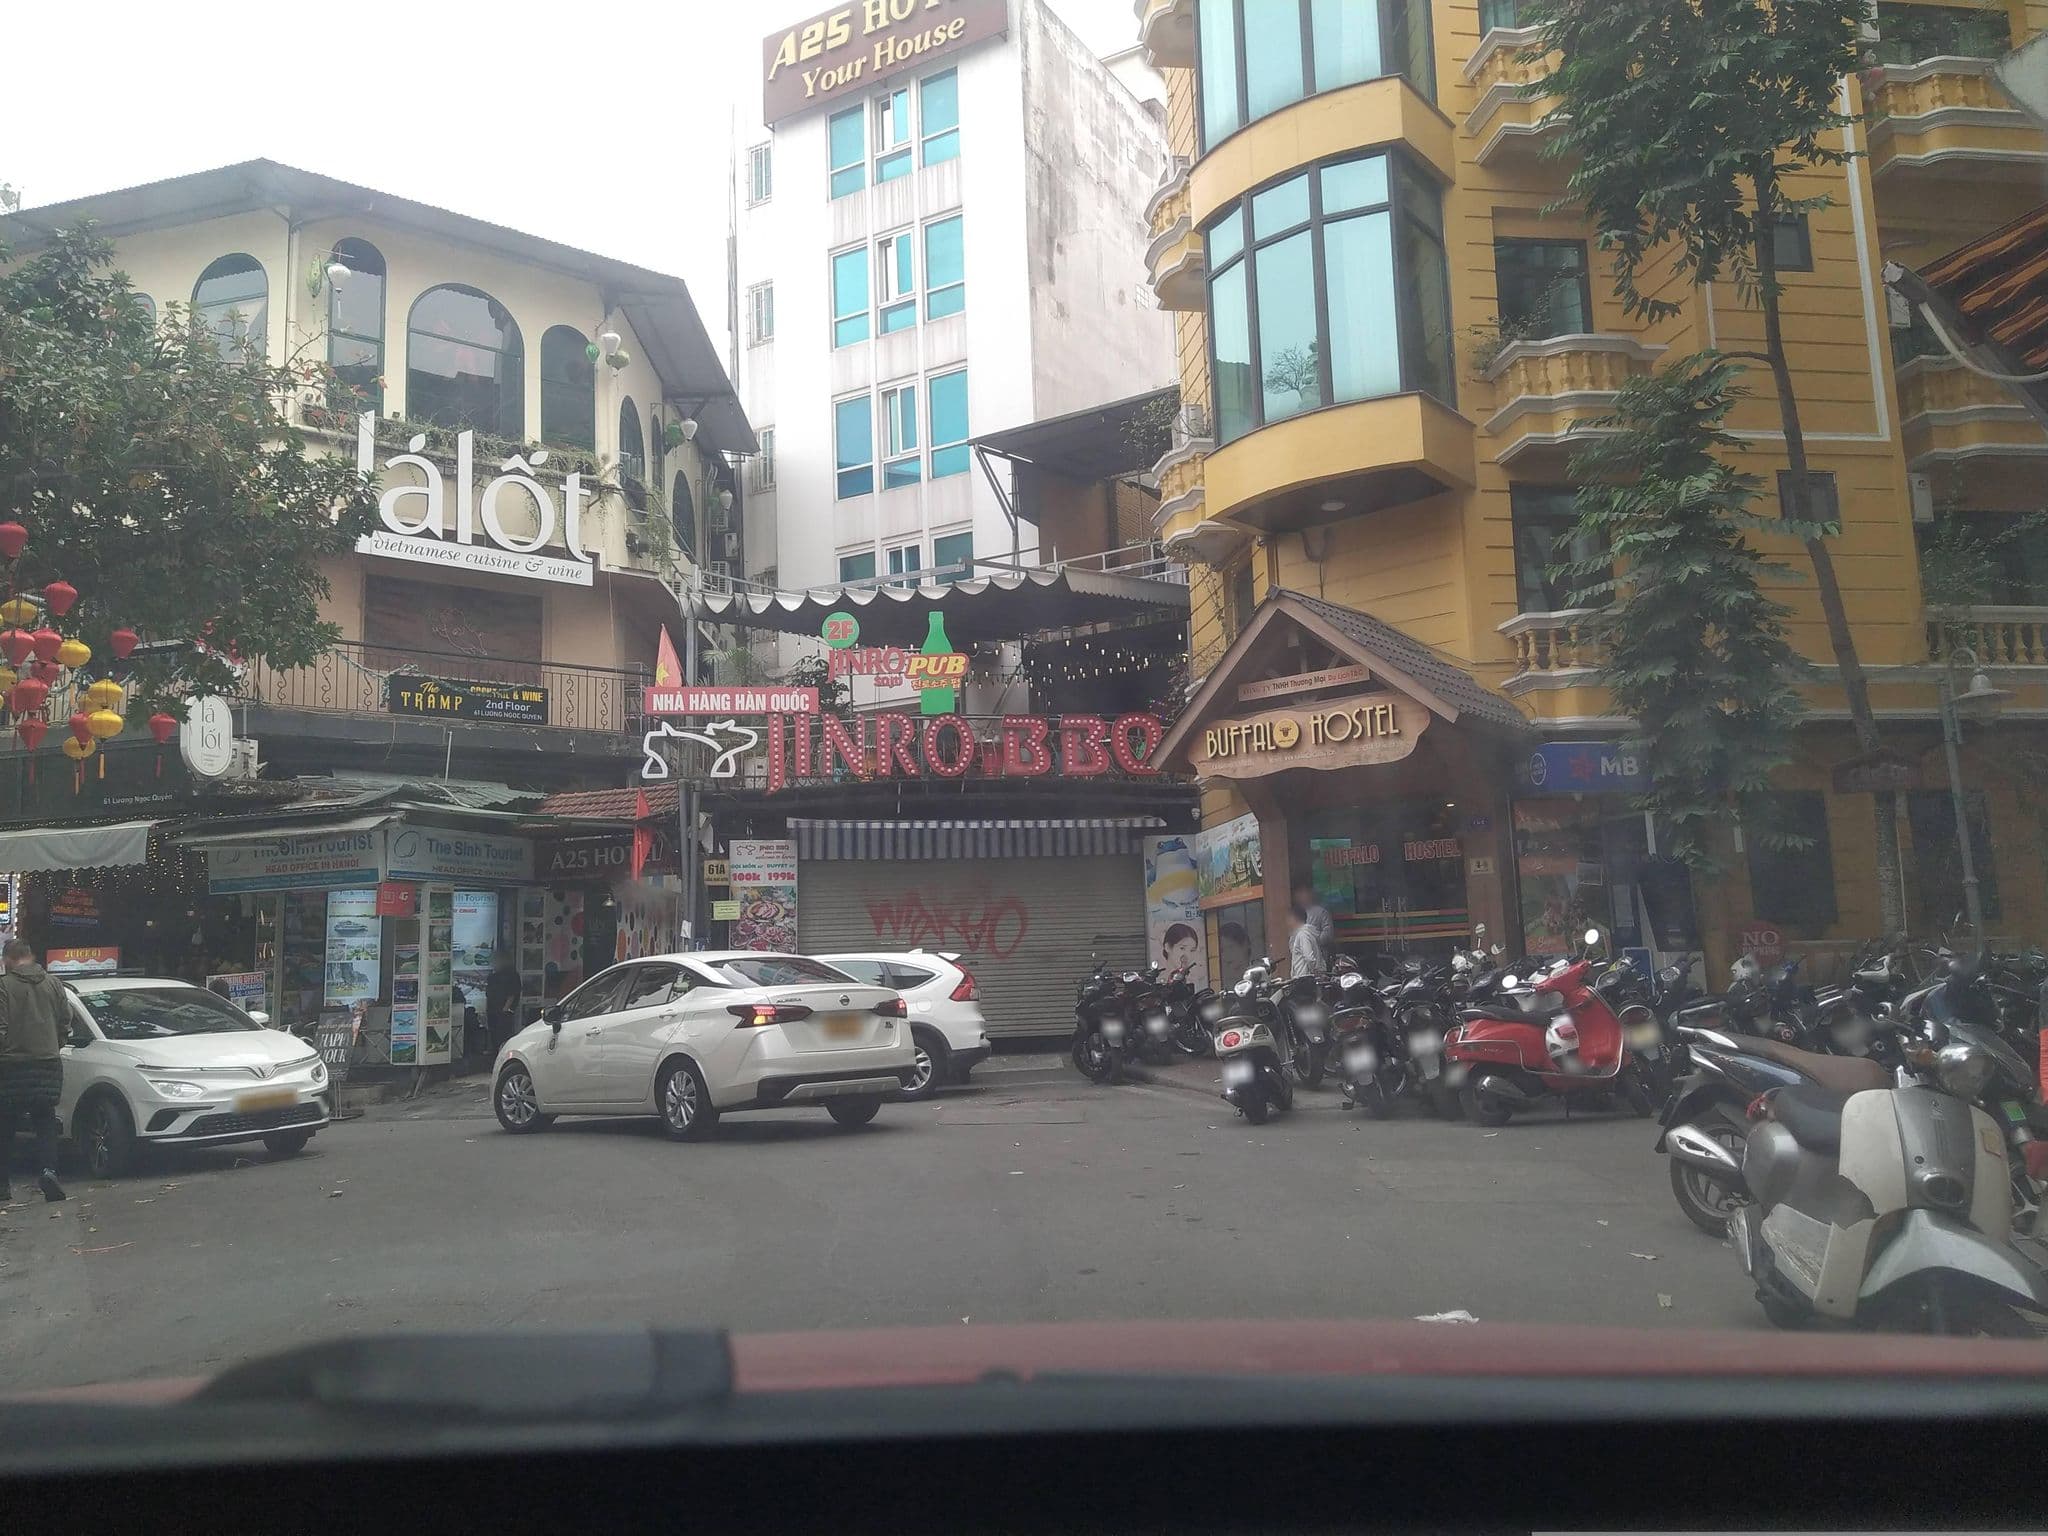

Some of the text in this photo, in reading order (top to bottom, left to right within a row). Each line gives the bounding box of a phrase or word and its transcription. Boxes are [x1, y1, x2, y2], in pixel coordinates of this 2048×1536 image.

[768, 0, 940, 81] A25 HO
[802, 17, 966, 98] Your House
[373, 535, 583, 580] vietnamese cuisine & wine
[827, 620, 854, 640] 2F
[826, 647, 967, 684] JINRO PUB
[420, 682, 440, 694] The
[513, 691, 519, 700] &
[522, 691, 544, 702] WINE
[401, 691, 463, 711] TRAMP
[486, 700, 531, 712] 2nd Floor
[653, 688, 810, 712] NHÀ HÀNG HÀN QUỐC
[1309, 704, 1402, 745] HOSTEL
[767, 712, 1162, 796] JINRO BBQ
[1601, 756, 1639, 776] MB
[426, 838, 452, 855] The
[265, 863, 288, 874] HEAD
[290, 861, 319, 872] OFFICE
[551, 849, 588, 869] A25
[708, 863, 726, 875] 61A
[732, 872, 760, 881] 100k
[767, 872, 795, 881] 199k
[1742, 930, 1780, 946] NO
